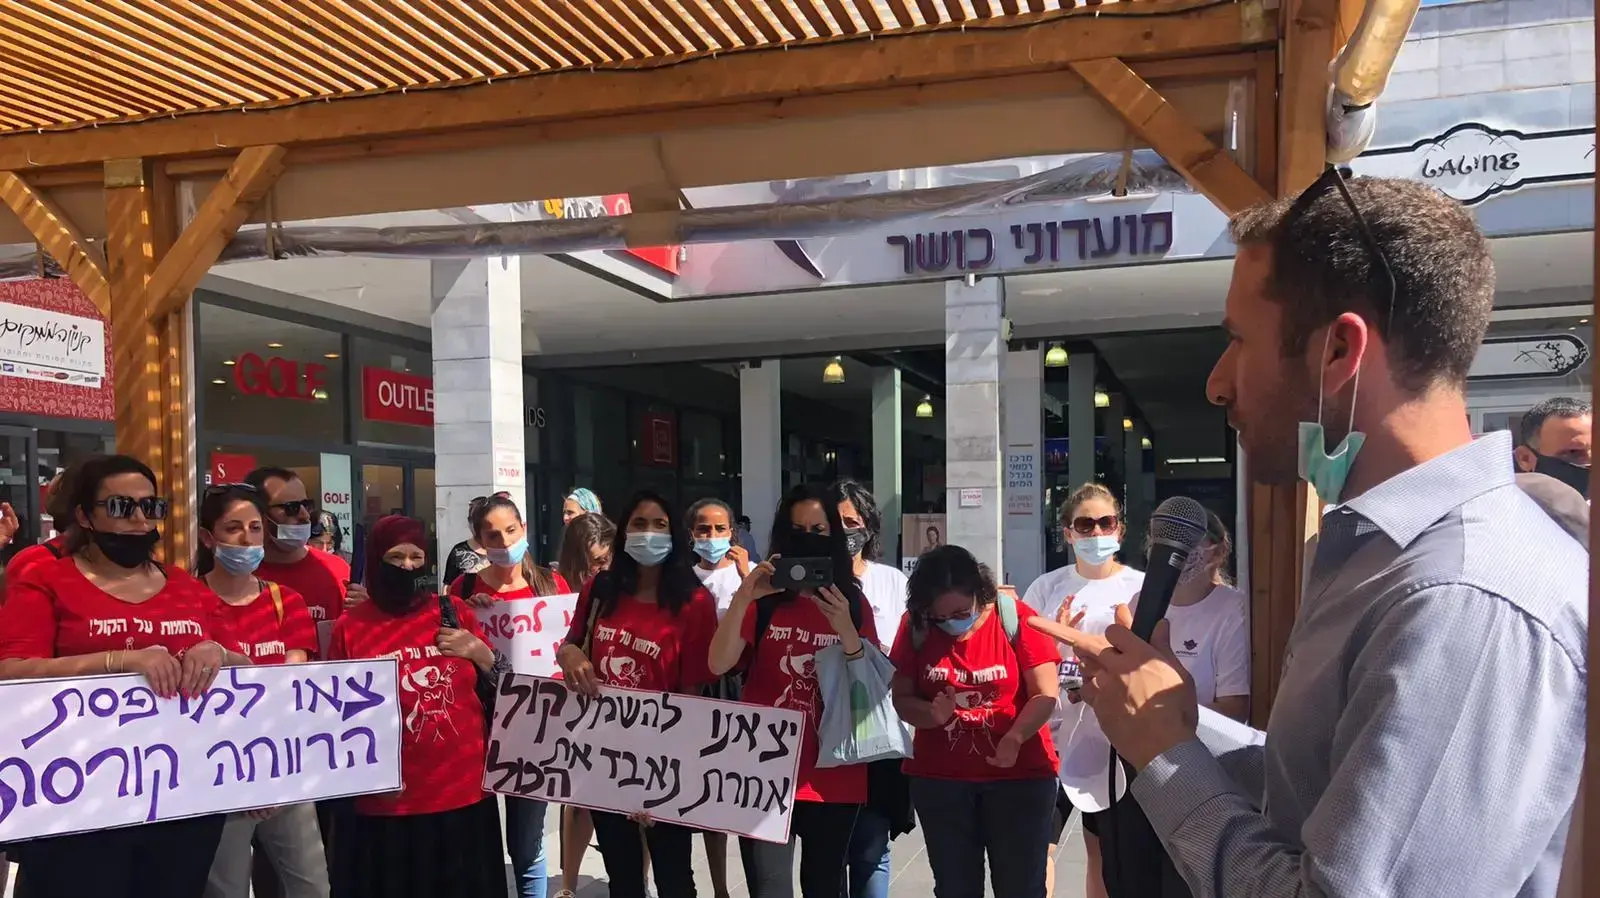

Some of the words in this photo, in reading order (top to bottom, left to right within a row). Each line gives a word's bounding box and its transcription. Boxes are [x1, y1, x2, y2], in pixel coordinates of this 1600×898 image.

[1421, 152, 1521, 178] LALINE
[1009, 211, 1173, 264] מועדוני
[886, 228, 996, 274] כושר
[234, 351, 328, 400] GOLF
[378, 380, 434, 412] OUTLE
[525, 405, 546, 428] IDS
[1009, 463, 1033, 471] רפואי
[1009, 471, 1033, 479] מגדל
[1009, 480, 1033, 488] המים
[323, 492, 350, 504] GOLF
[133, 617, 153, 634] על
[619, 628, 632, 646] על
[796, 627, 810, 643] על
[405, 646, 420, 659] על
[795, 679, 814, 692] SW
[953, 667, 967, 684] על
[292, 670, 385, 722] צאו
[423, 690, 443, 702] SW
[961, 711, 981, 722] SW
[699, 708, 798, 763] יצאנו
[206, 726, 379, 786] הרווחה
[539, 737, 593, 772] את
[487, 740, 572, 798] הכול
[600, 747, 681, 809] נאבד
[0, 743, 180, 823] קורסת
[677, 768, 791, 817] אחרת
